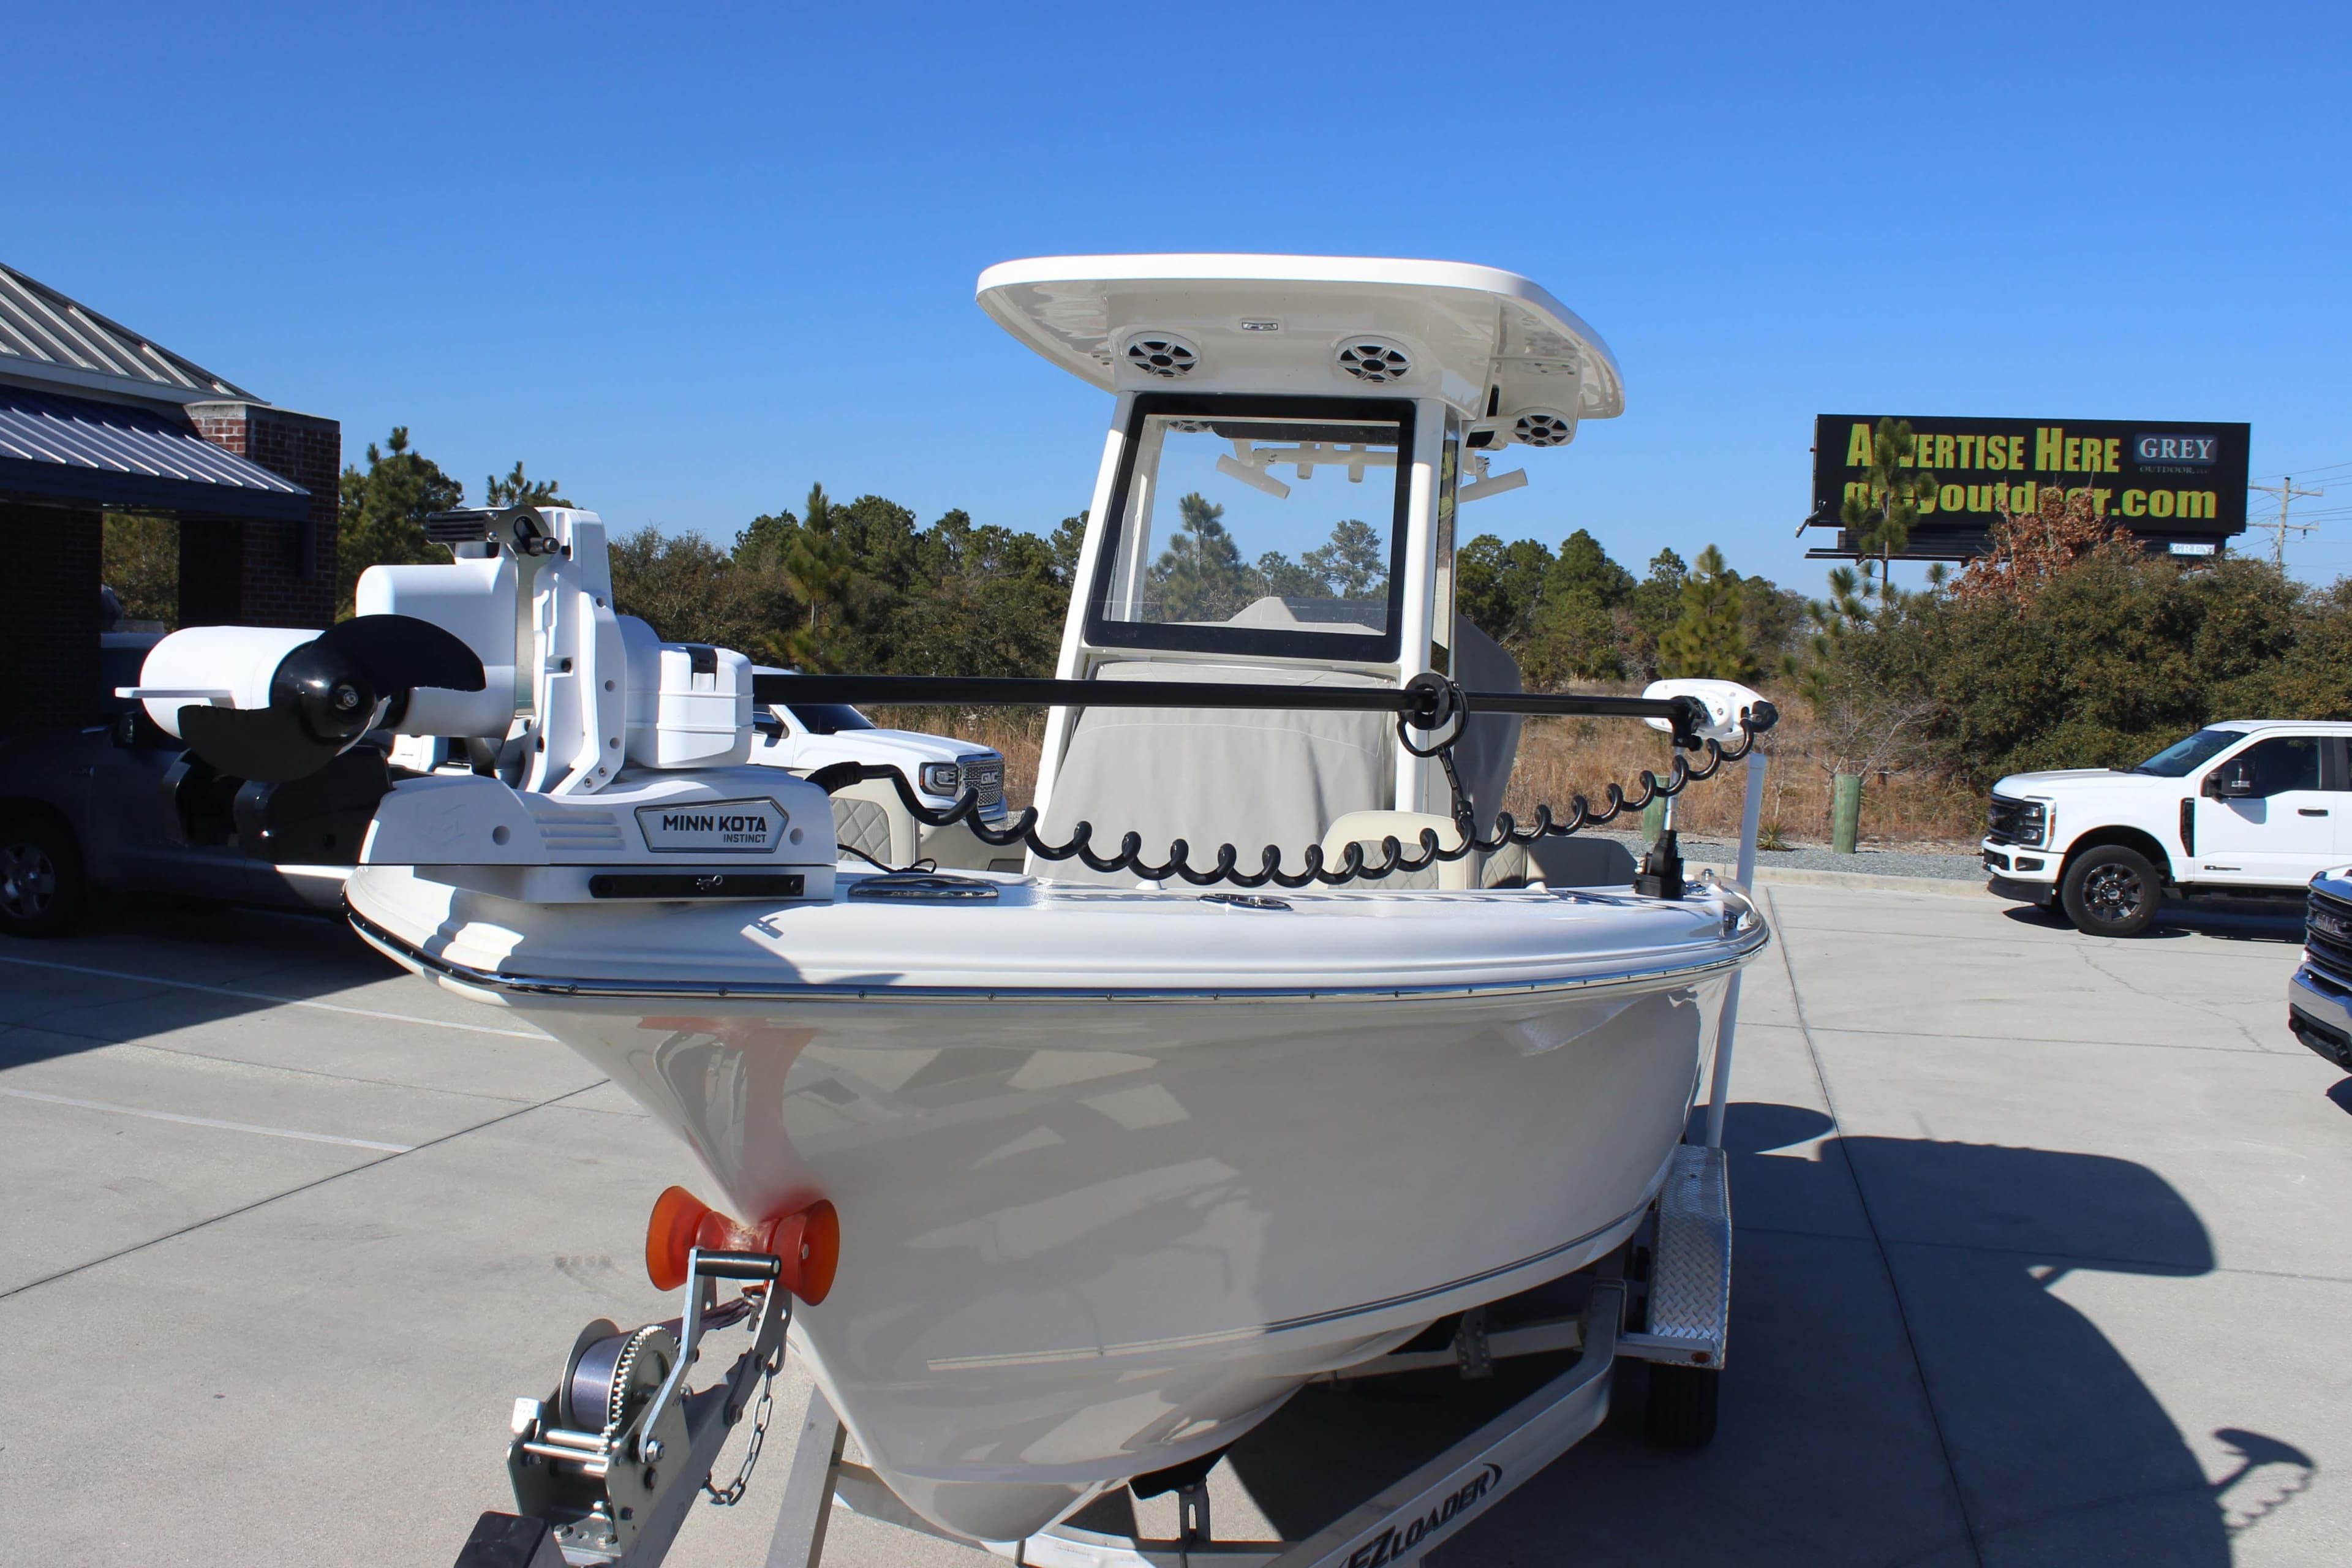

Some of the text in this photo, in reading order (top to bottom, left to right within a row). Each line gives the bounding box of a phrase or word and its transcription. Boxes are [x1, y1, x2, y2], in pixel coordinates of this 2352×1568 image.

[2035, 427, 2120, 472] HERE
[2139, 437, 2214, 459] GREY
[981, 772, 998, 784] GMC
[663, 815, 767, 832] MINN KOTA
[723, 834, 767, 843] INSTINCT
